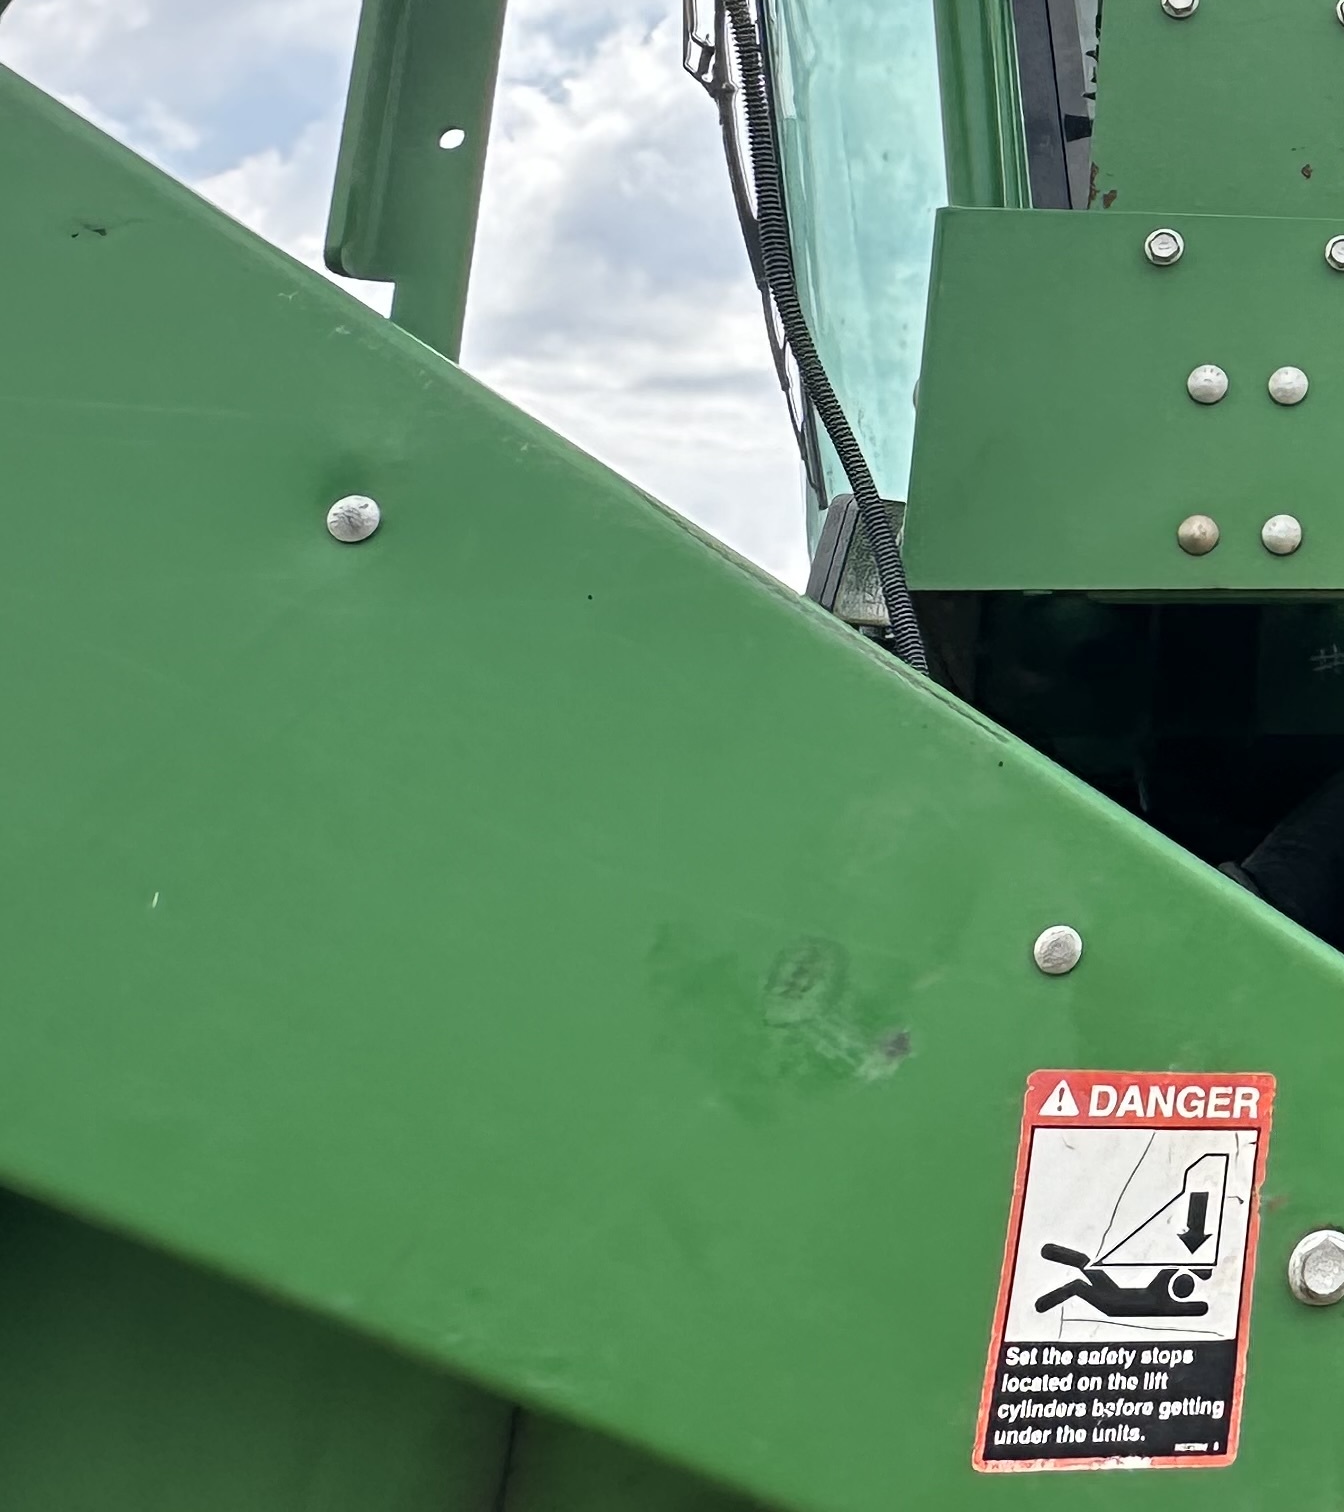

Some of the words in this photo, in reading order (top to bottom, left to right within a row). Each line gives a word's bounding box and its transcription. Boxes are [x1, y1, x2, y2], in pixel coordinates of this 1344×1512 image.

[1088, 1085, 1261, 1119] DANGER
[1005, 1346, 1039, 1366] Set
[1043, 1346, 1073, 1365] the
[1078, 1346, 1136, 1369] safety
[1141, 1346, 1194, 1366] stops
[1002, 1373, 1073, 1392] located
[1077, 1375, 1102, 1391] on
[1107, 1373, 1139, 1390] the
[1143, 1373, 1169, 1390] lift
[997, 1400, 1087, 1423] cylinders
[1091, 1399, 1154, 1419] before
[1159, 1398, 1225, 1419] getting
[994, 1426, 1051, 1446] under
[1056, 1425, 1086, 1444] the
[1091, 1424, 1146, 1443] units.
